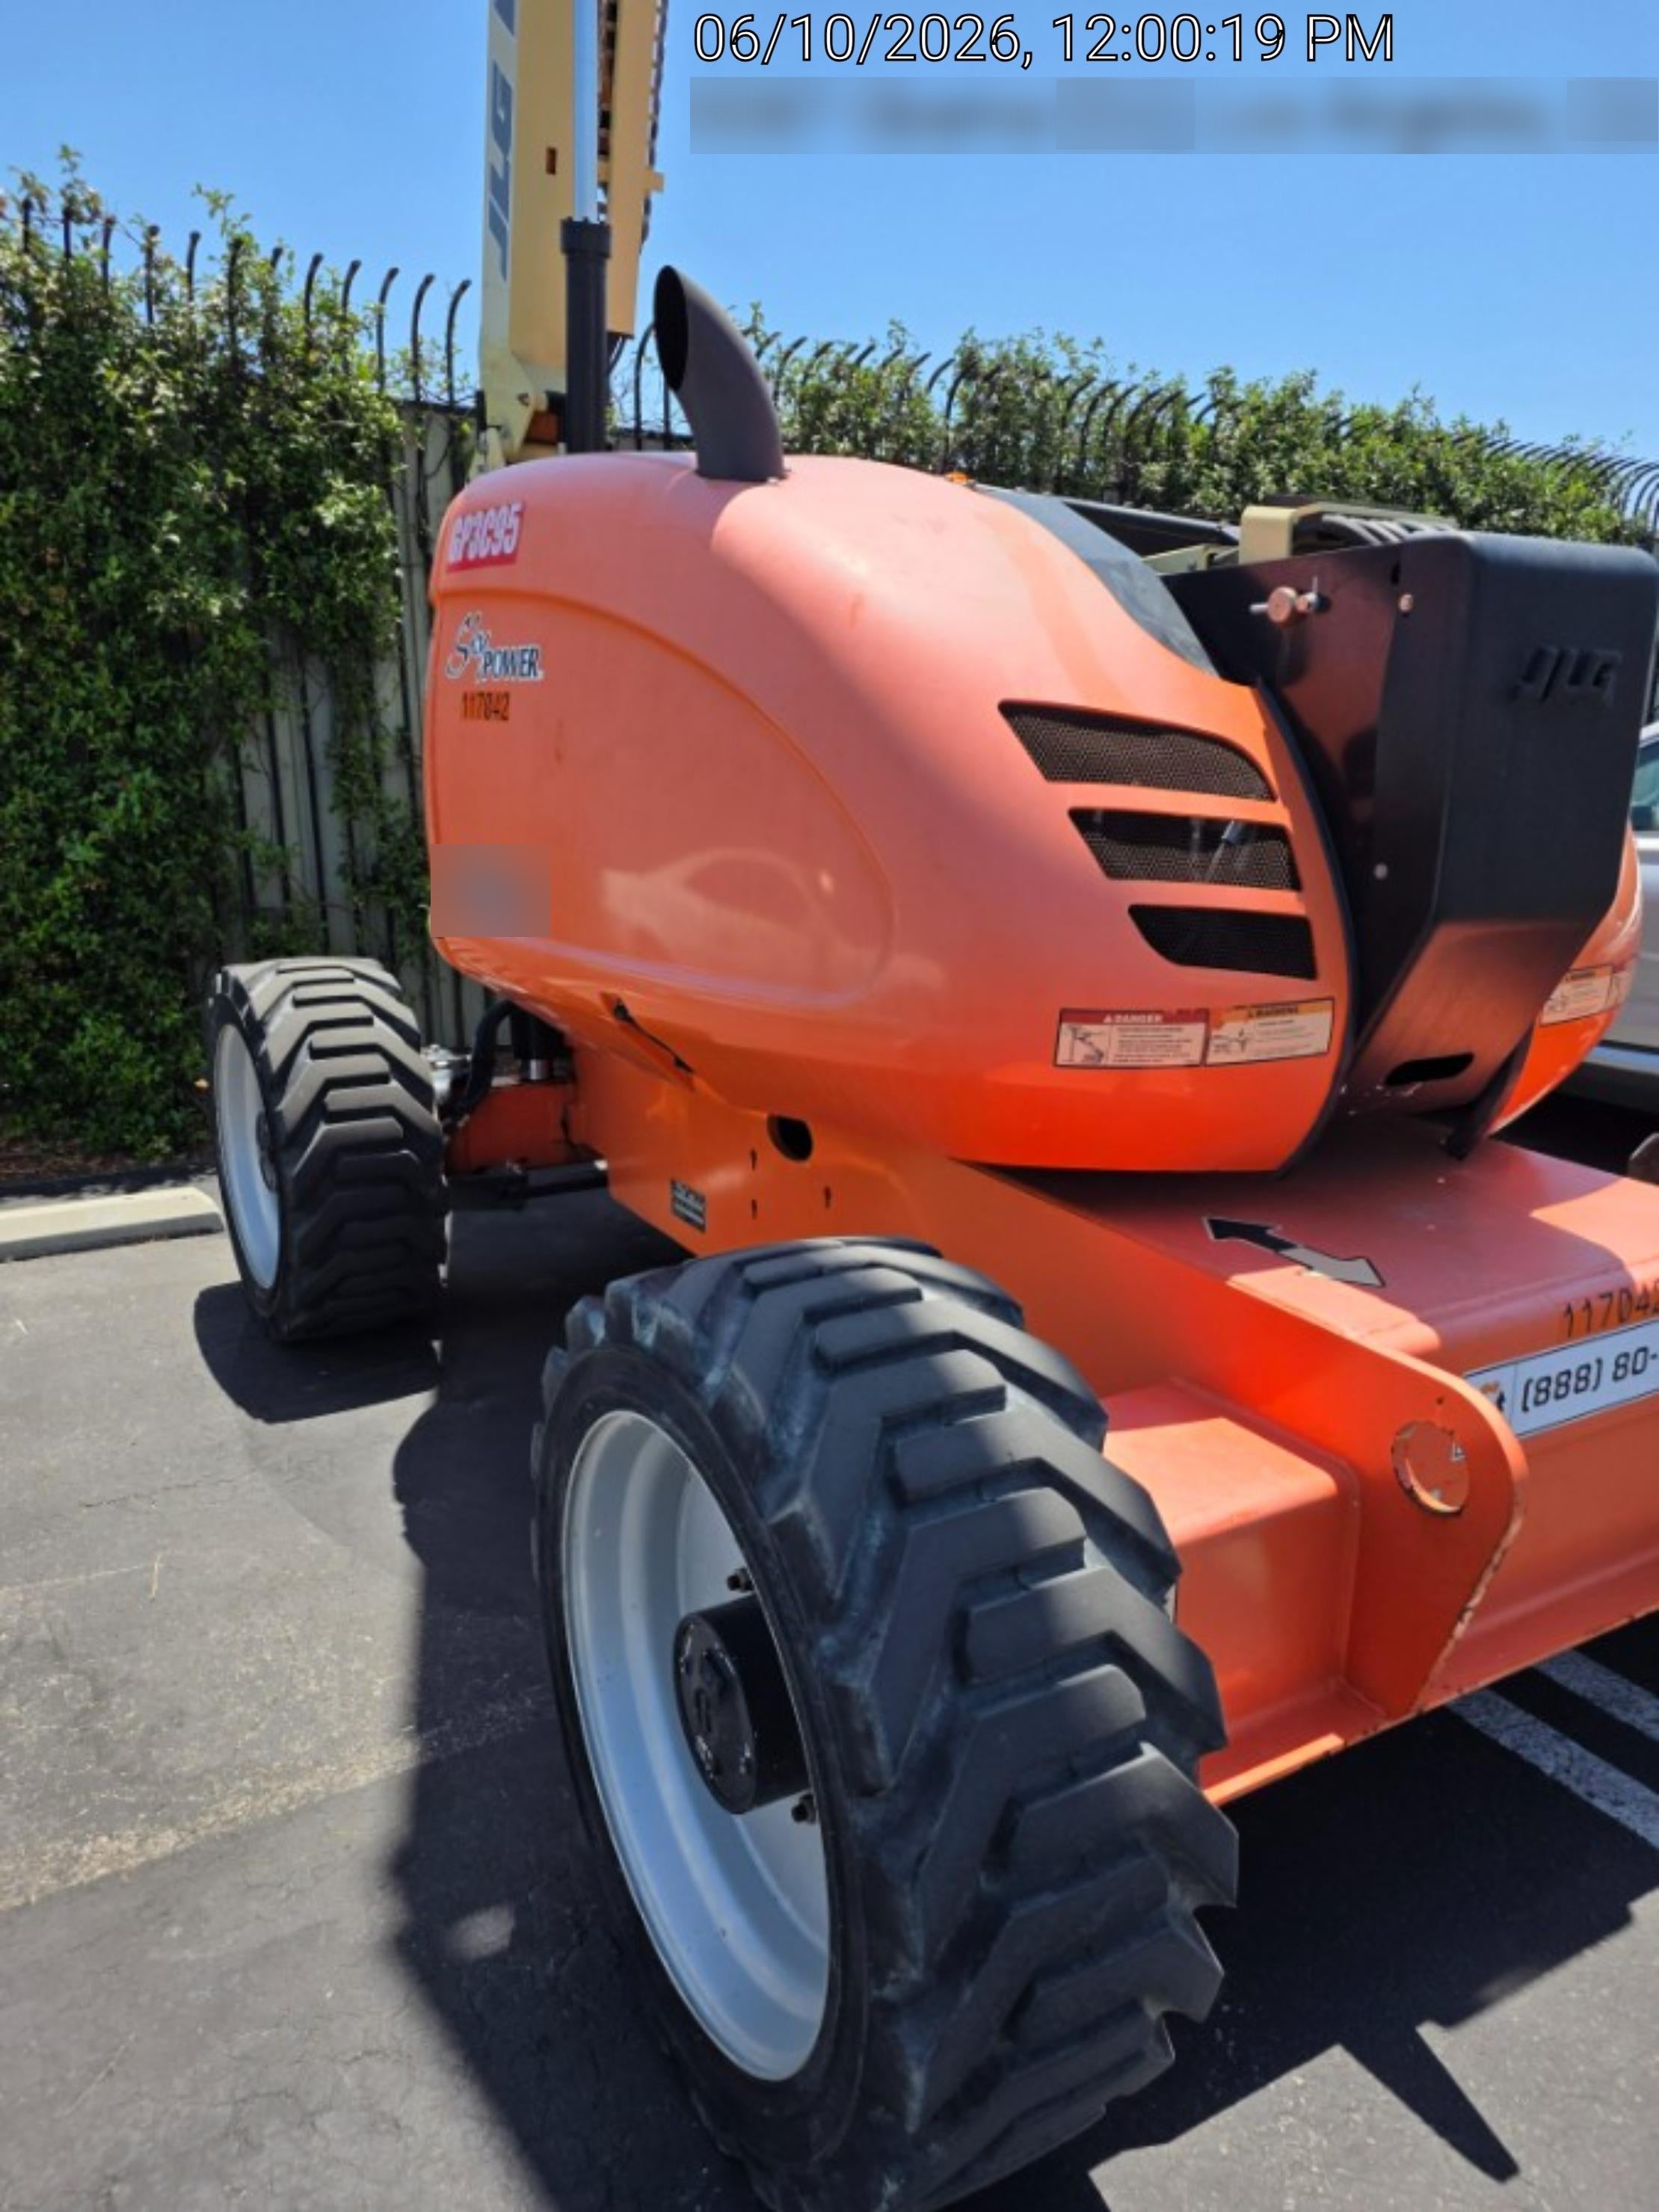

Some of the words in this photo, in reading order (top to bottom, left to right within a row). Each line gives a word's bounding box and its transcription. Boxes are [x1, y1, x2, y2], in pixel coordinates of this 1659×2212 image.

[488, 60, 513, 282] JLG
[1114, 1014, 1163, 1024] DANGER
[1521, 1357, 1604, 1413] (888)
